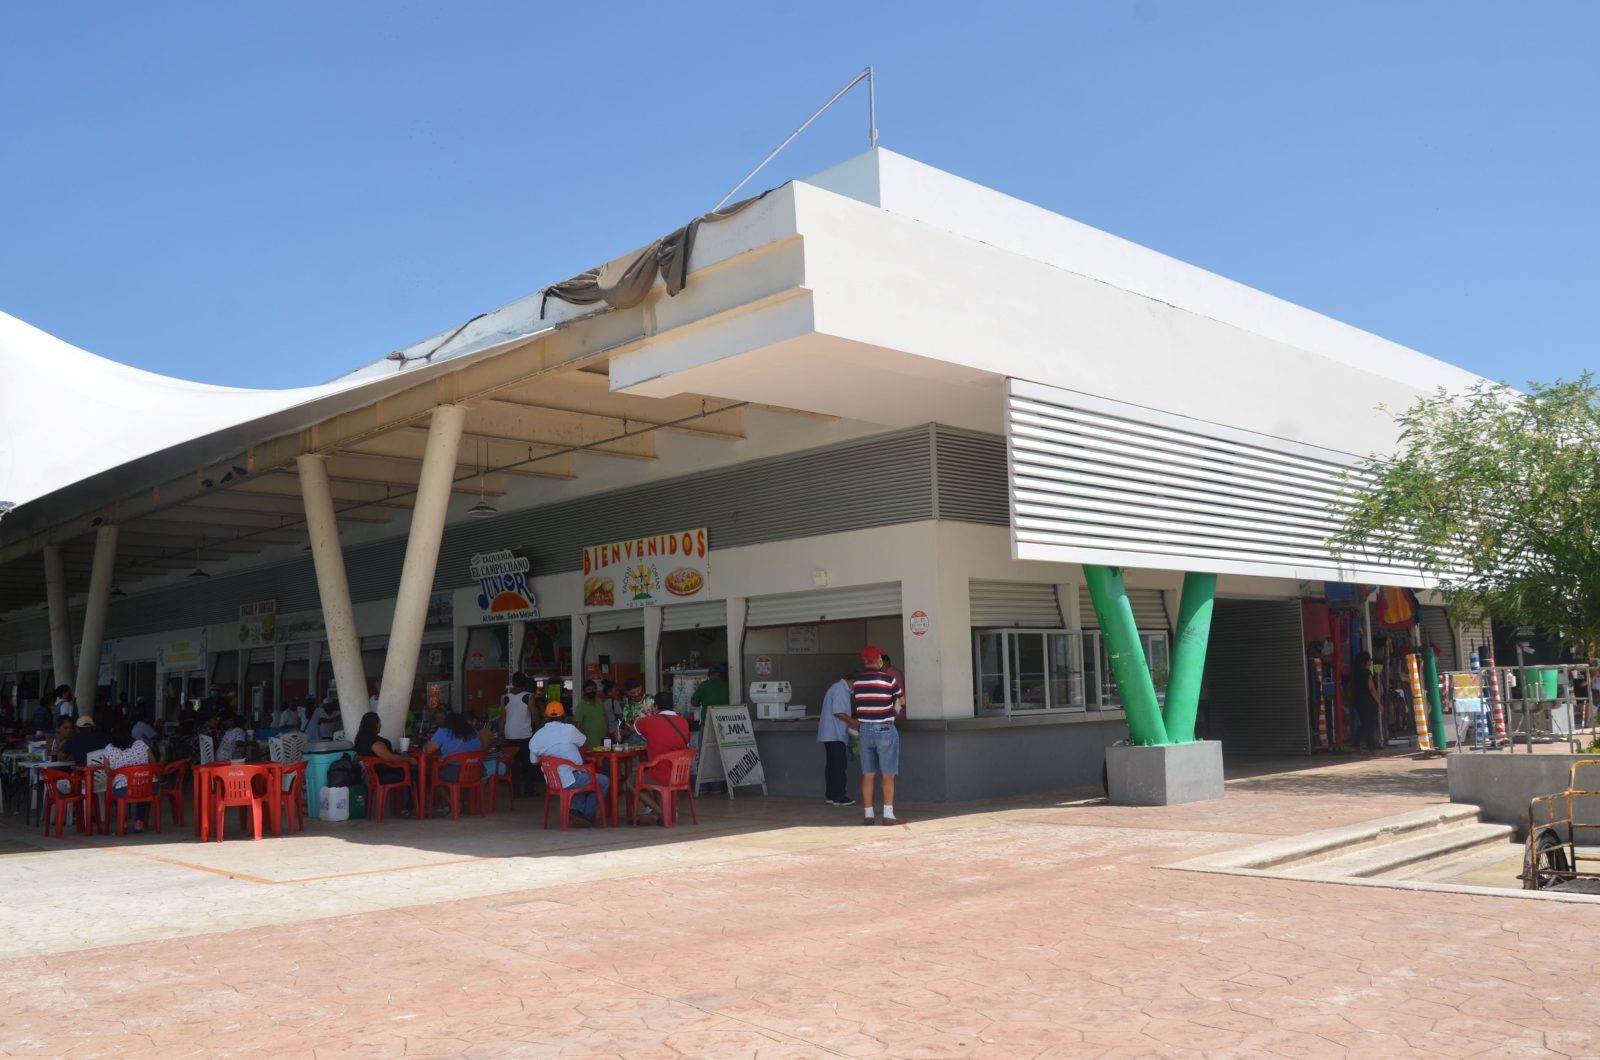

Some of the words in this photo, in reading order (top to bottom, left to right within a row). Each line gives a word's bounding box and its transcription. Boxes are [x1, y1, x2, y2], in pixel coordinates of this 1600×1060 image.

[471, 567, 480, 577] EL
[481, 558, 528, 574] CAMPECHANO
[583, 528, 705, 576] BIENVENIDOS
[478, 572, 534, 610] JUNIOR
[622, 566, 631, 594] TACOS
[727, 747, 760, 785] TORTILLERÍA
